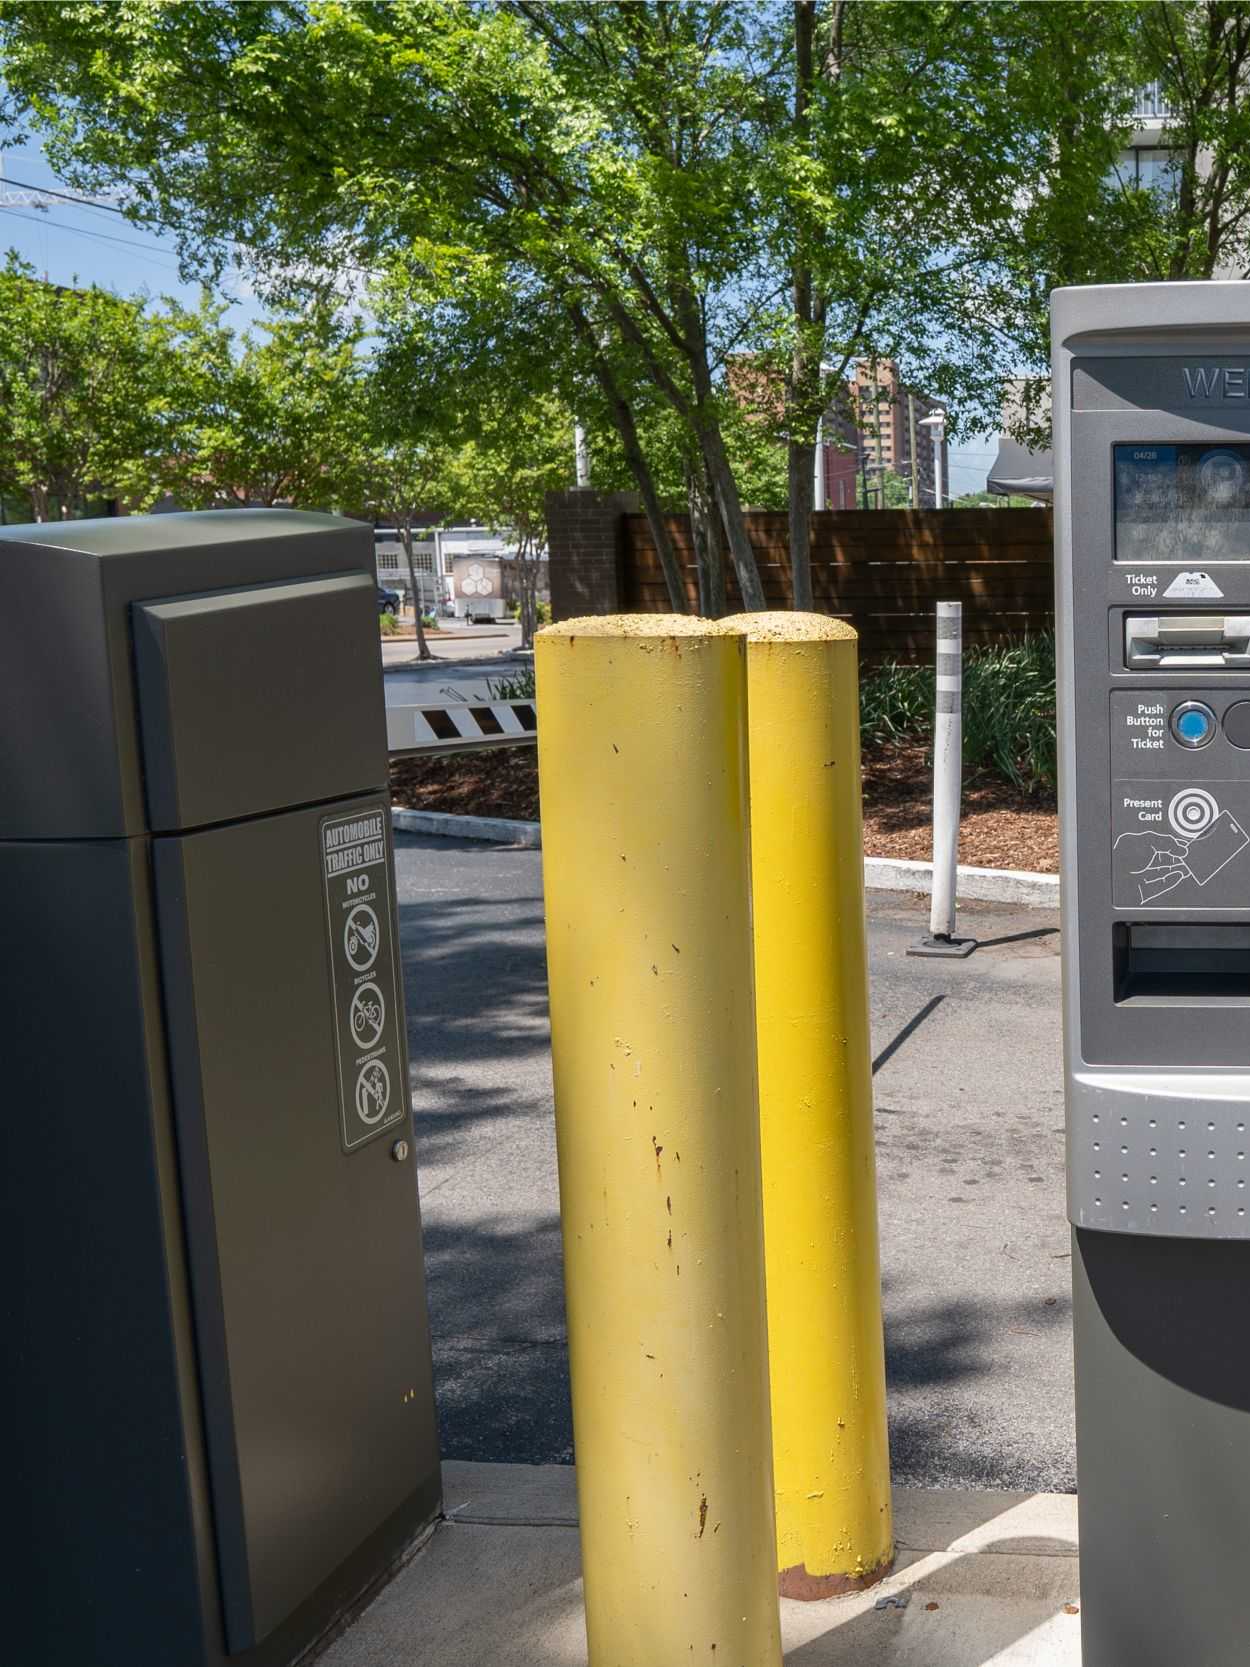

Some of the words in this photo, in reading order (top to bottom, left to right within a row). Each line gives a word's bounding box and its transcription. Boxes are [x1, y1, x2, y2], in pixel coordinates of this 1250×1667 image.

[1125, 573, 1158, 584] Ticket
[1132, 585, 1157, 598] Only
[1138, 704, 1164, 714] Push
[1126, 716, 1164, 726] Button
[1147, 727, 1164, 737] for
[1131, 738, 1164, 749] Ticket
[1123, 798, 1162, 808] Present
[1138, 811, 1162, 821] Card
[326, 817, 382, 848] AUTOMOBILE
[326, 846, 363, 873] TRAFFIC
[363, 840, 384, 862] ONLY
[346, 874, 370, 895] NO
